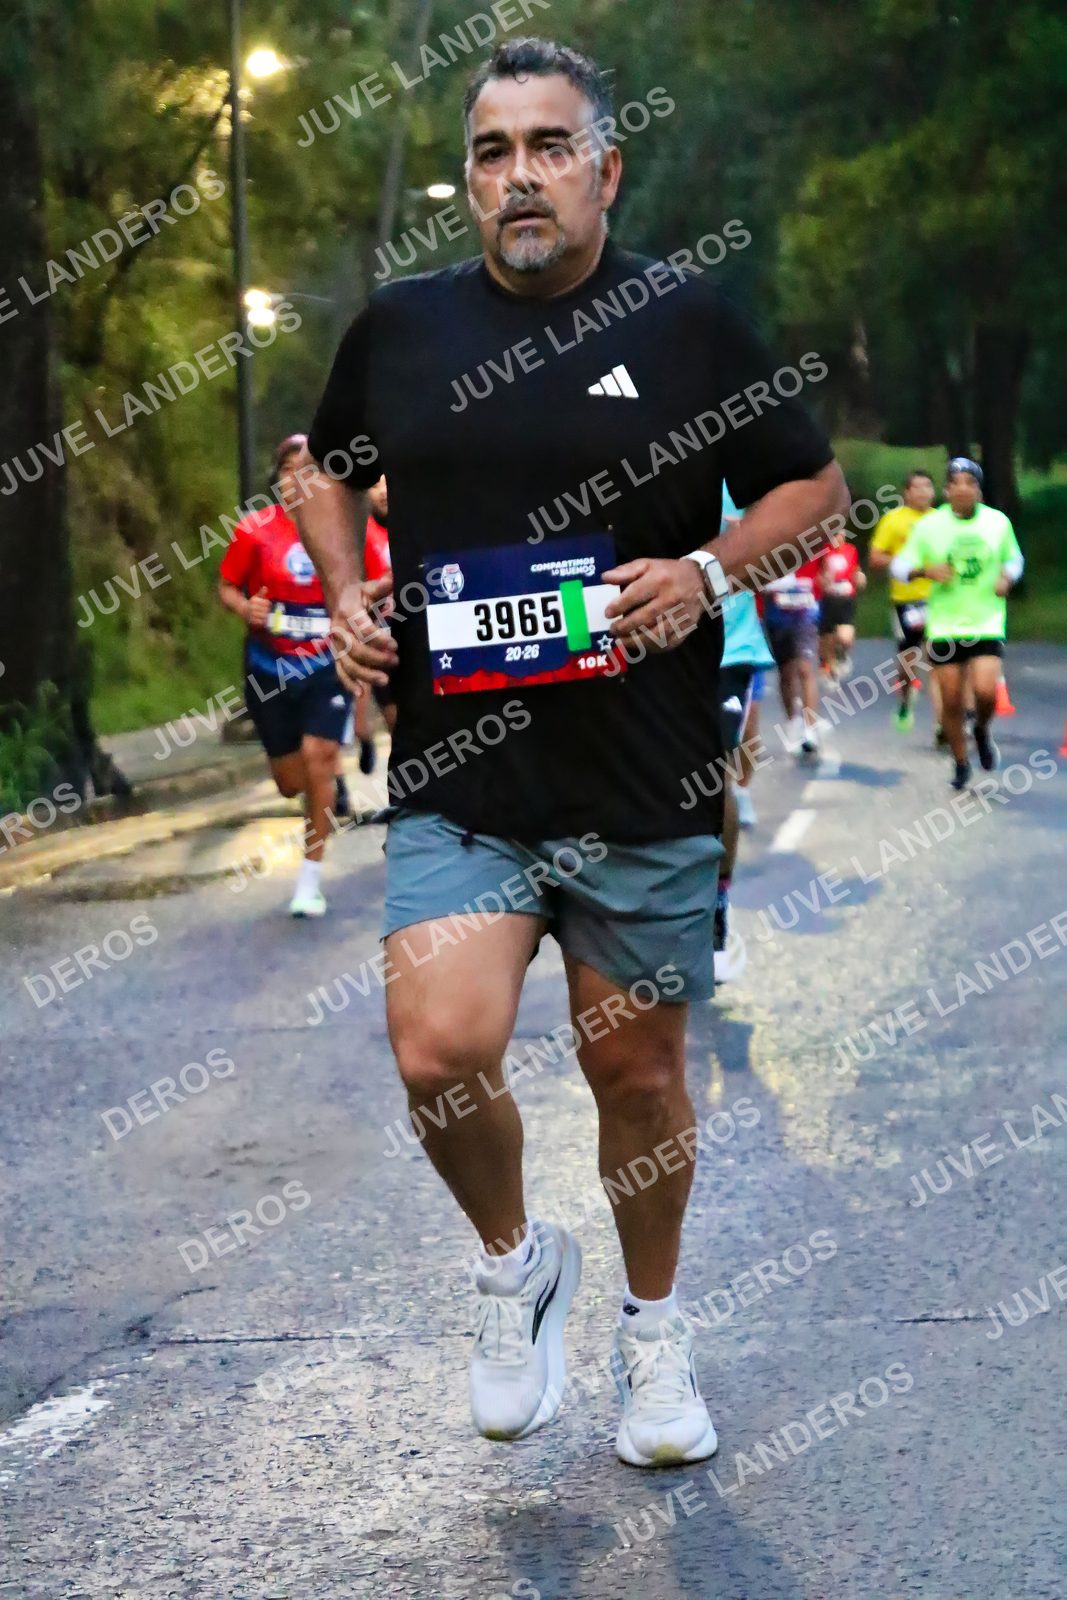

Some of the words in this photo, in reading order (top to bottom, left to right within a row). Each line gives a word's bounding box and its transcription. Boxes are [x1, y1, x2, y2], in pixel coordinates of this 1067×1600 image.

[530, 556, 595, 573] COMPARTIMOS
[474, 595, 562, 642] 3965
[577, 654, 608, 670] 10K
